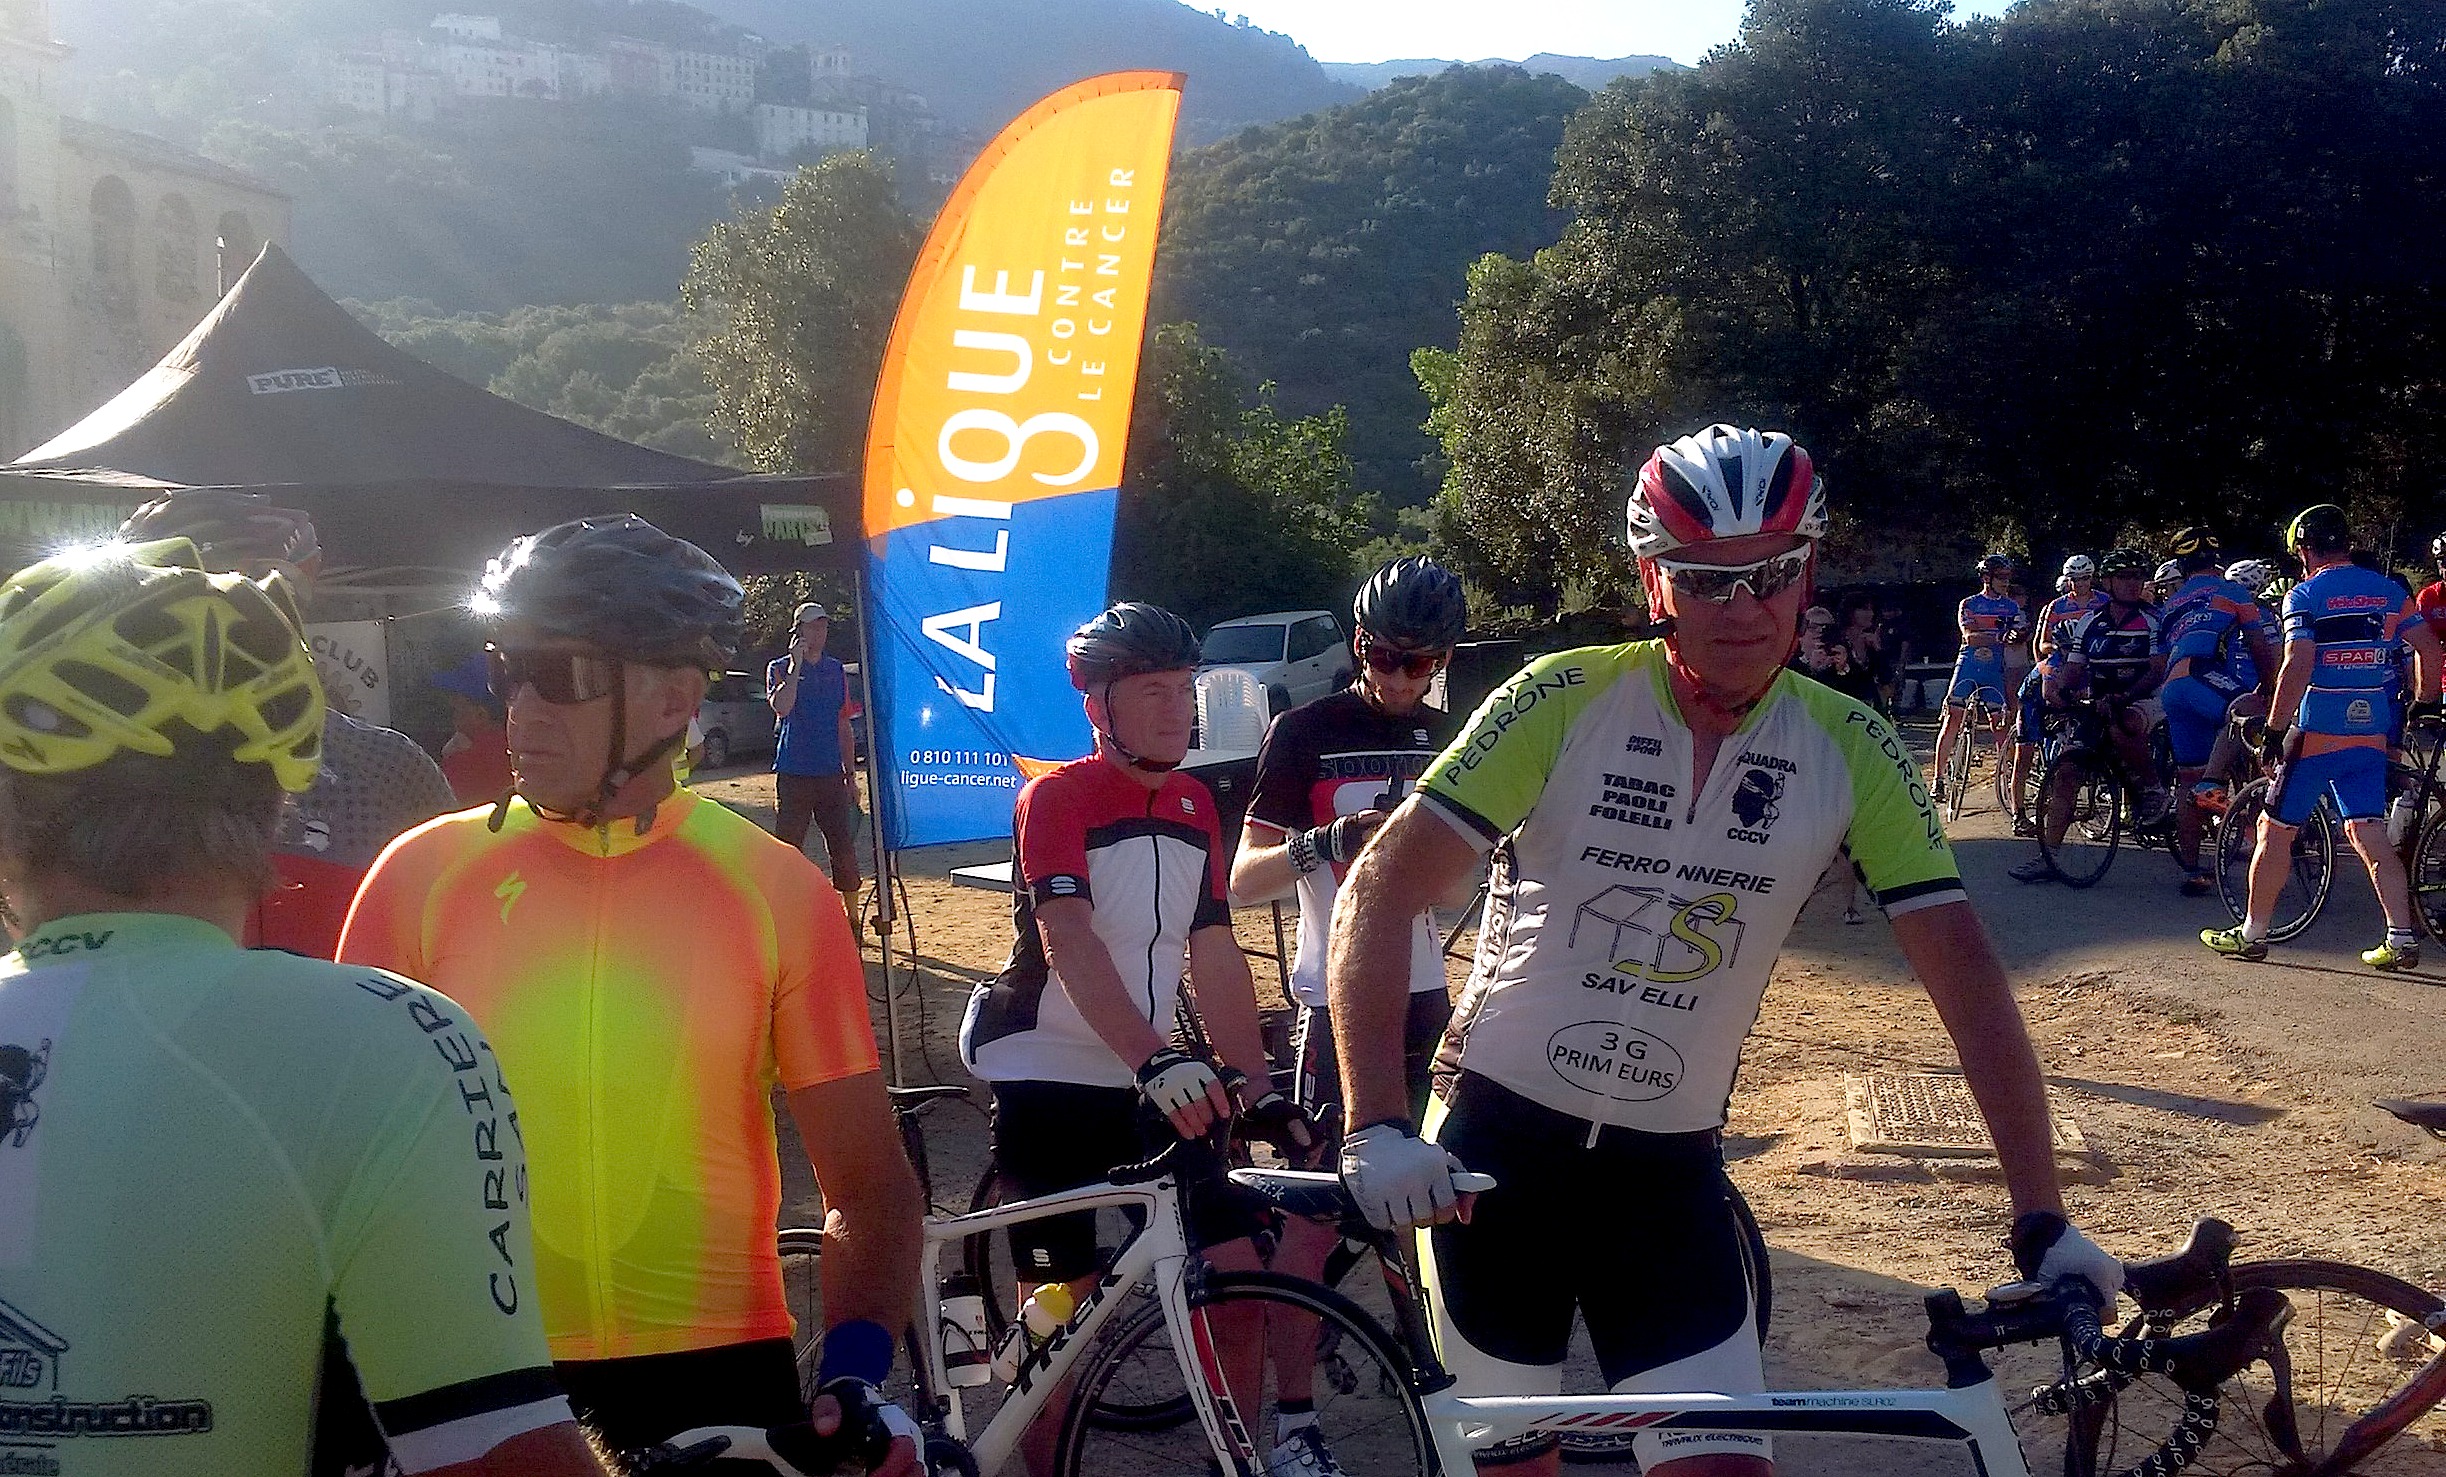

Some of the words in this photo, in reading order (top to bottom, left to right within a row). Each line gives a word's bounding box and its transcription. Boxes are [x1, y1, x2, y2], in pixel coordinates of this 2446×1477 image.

[1088, 167, 1135, 336] CANCER
[1048, 200, 1093, 365] CONTRE
[1078, 360, 1106, 401] LE
[311, 634, 379, 689] CLUB
[922, 601, 1001, 714] LA
[2325, 651, 2375, 662] SPAR
[1445, 667, 1586, 787] PEDRONE
[910, 750, 921, 764] 0
[923, 750, 951, 764] 810
[955, 751, 978, 765] 111
[984, 752, 1008, 767] 101
[1738, 751, 1798, 775] QUADRA
[900, 770, 1017, 788] ligue-cancer.net
[1602, 773, 1676, 799] TABAC
[1845, 710, 1944, 850] PEDRONE
[1602, 790, 1668, 814] PAOLI
[1589, 804, 1673, 830] FOLELLI
[1727, 828, 1771, 845] CCCV
[1600, 1031, 1619, 1051] 3
[1625, 1040, 1648, 1060] G
[356, 974, 518, 1315] CARRIERE
[1771, 1397, 1860, 1408] teammachine
